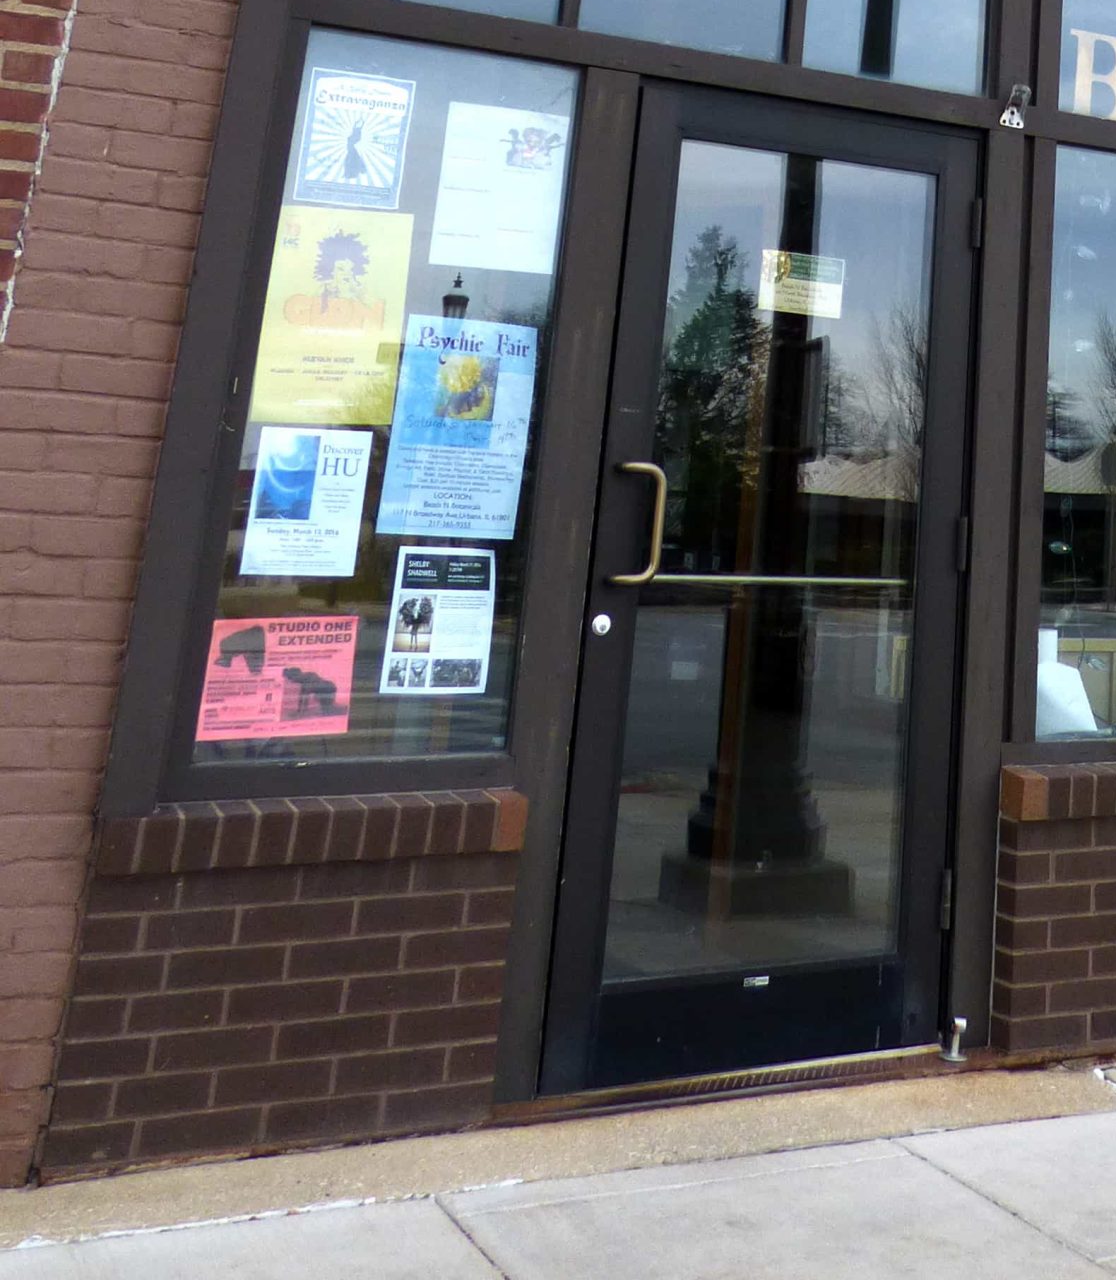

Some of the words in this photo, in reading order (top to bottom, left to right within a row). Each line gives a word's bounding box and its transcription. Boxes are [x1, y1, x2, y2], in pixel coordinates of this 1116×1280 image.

[315, 89, 406, 111] Extravaganza
[416, 326, 484, 365] Psychic
[496, 333, 530, 357] Fair
[323, 444, 364, 456] Discover
[321, 457, 361, 477] HU
[268, 621, 320, 633] STUDIO
[324, 621, 353, 632] ONE
[278, 633, 352, 646] EXTENDED
